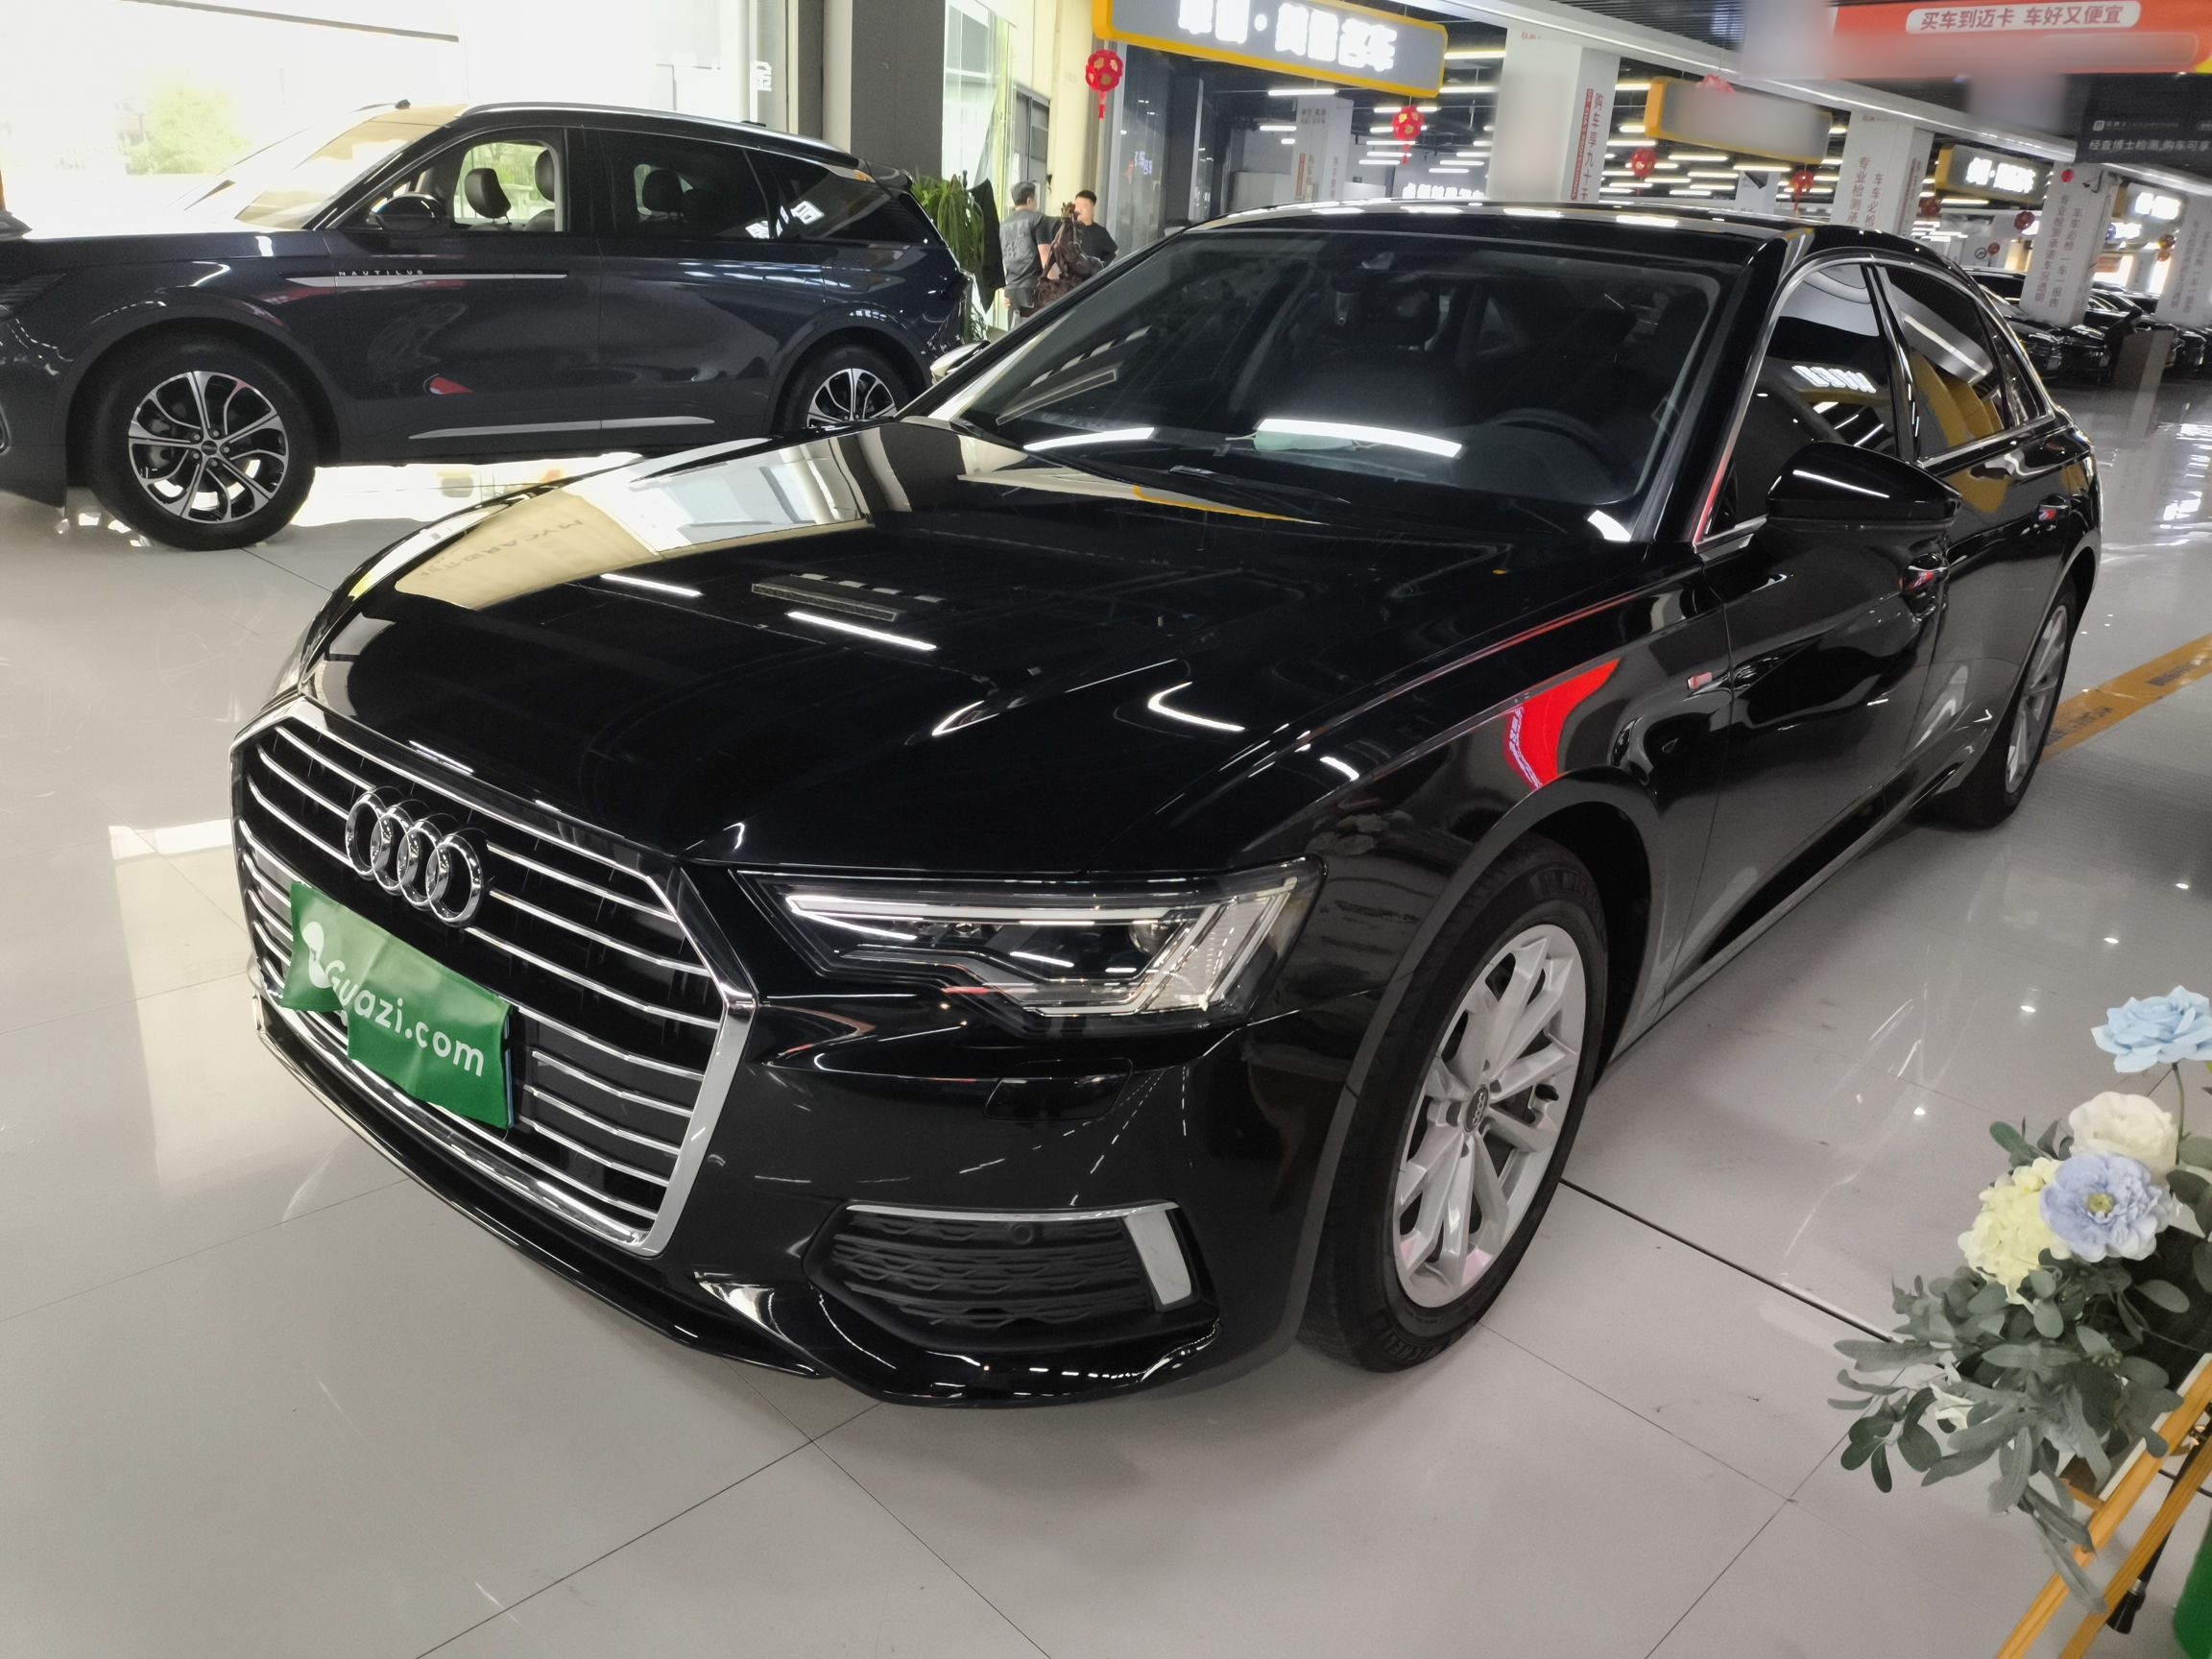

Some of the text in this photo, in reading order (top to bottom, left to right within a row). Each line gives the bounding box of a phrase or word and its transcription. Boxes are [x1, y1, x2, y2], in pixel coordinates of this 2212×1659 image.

[1919, 5, 2125, 31] 买车到迈卡 车好又便宜
[325, 959, 484, 1077] Guazi.com
